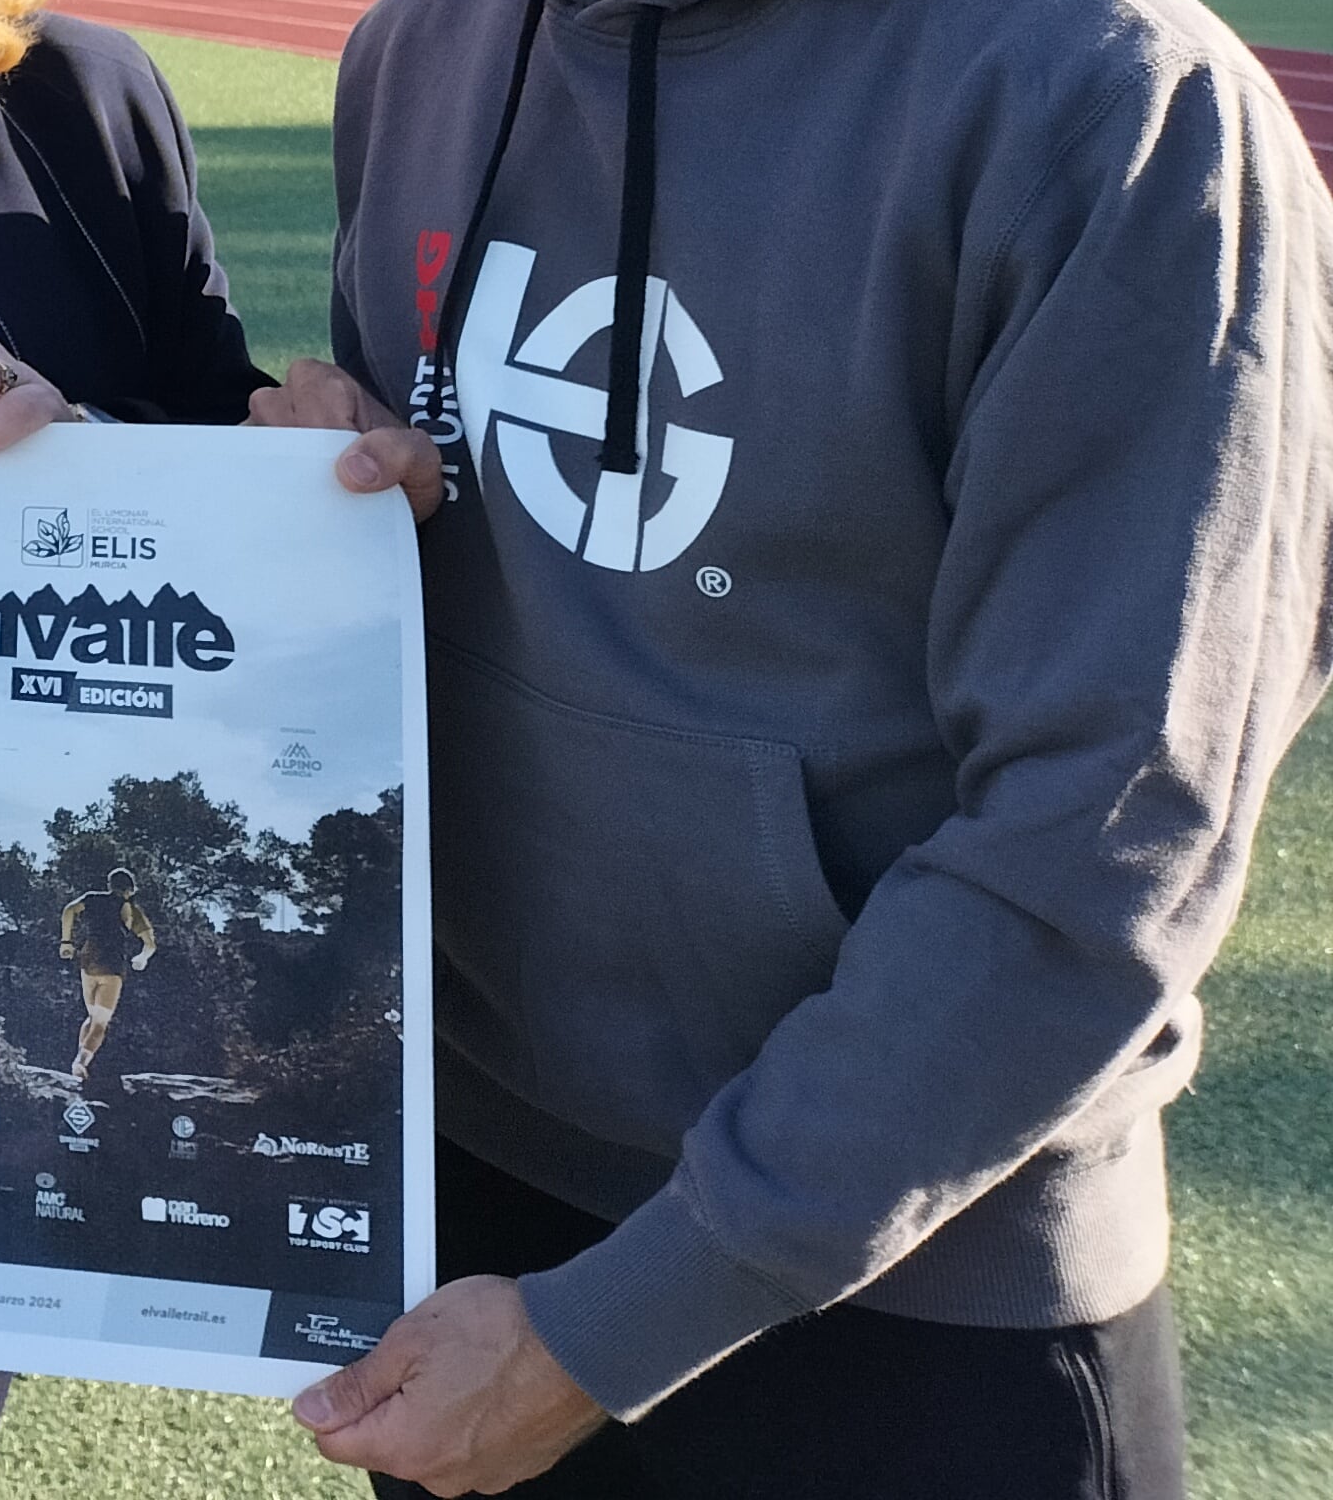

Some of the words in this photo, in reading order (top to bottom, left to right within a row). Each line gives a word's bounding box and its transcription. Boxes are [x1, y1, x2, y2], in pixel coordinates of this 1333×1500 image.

[91, 536, 157, 560] ELIS
[90, 561, 127, 570] MURCIA
[20, 674, 62, 696] XVI
[80, 686, 164, 709] EDICIÓN
[272, 758, 322, 771] ALPINO
[36, 1190, 66, 1207] AMC
[36, 1205, 86, 1222] NATURAL
[288, 1237, 309, 1246] TOP
[310, 1239, 342, 1250] SPORT
[343, 1243, 370, 1254] CLUB
[29, 1296, 62, 1311] 2024
[141, 1305, 227, 1325] elvalletrail.es
